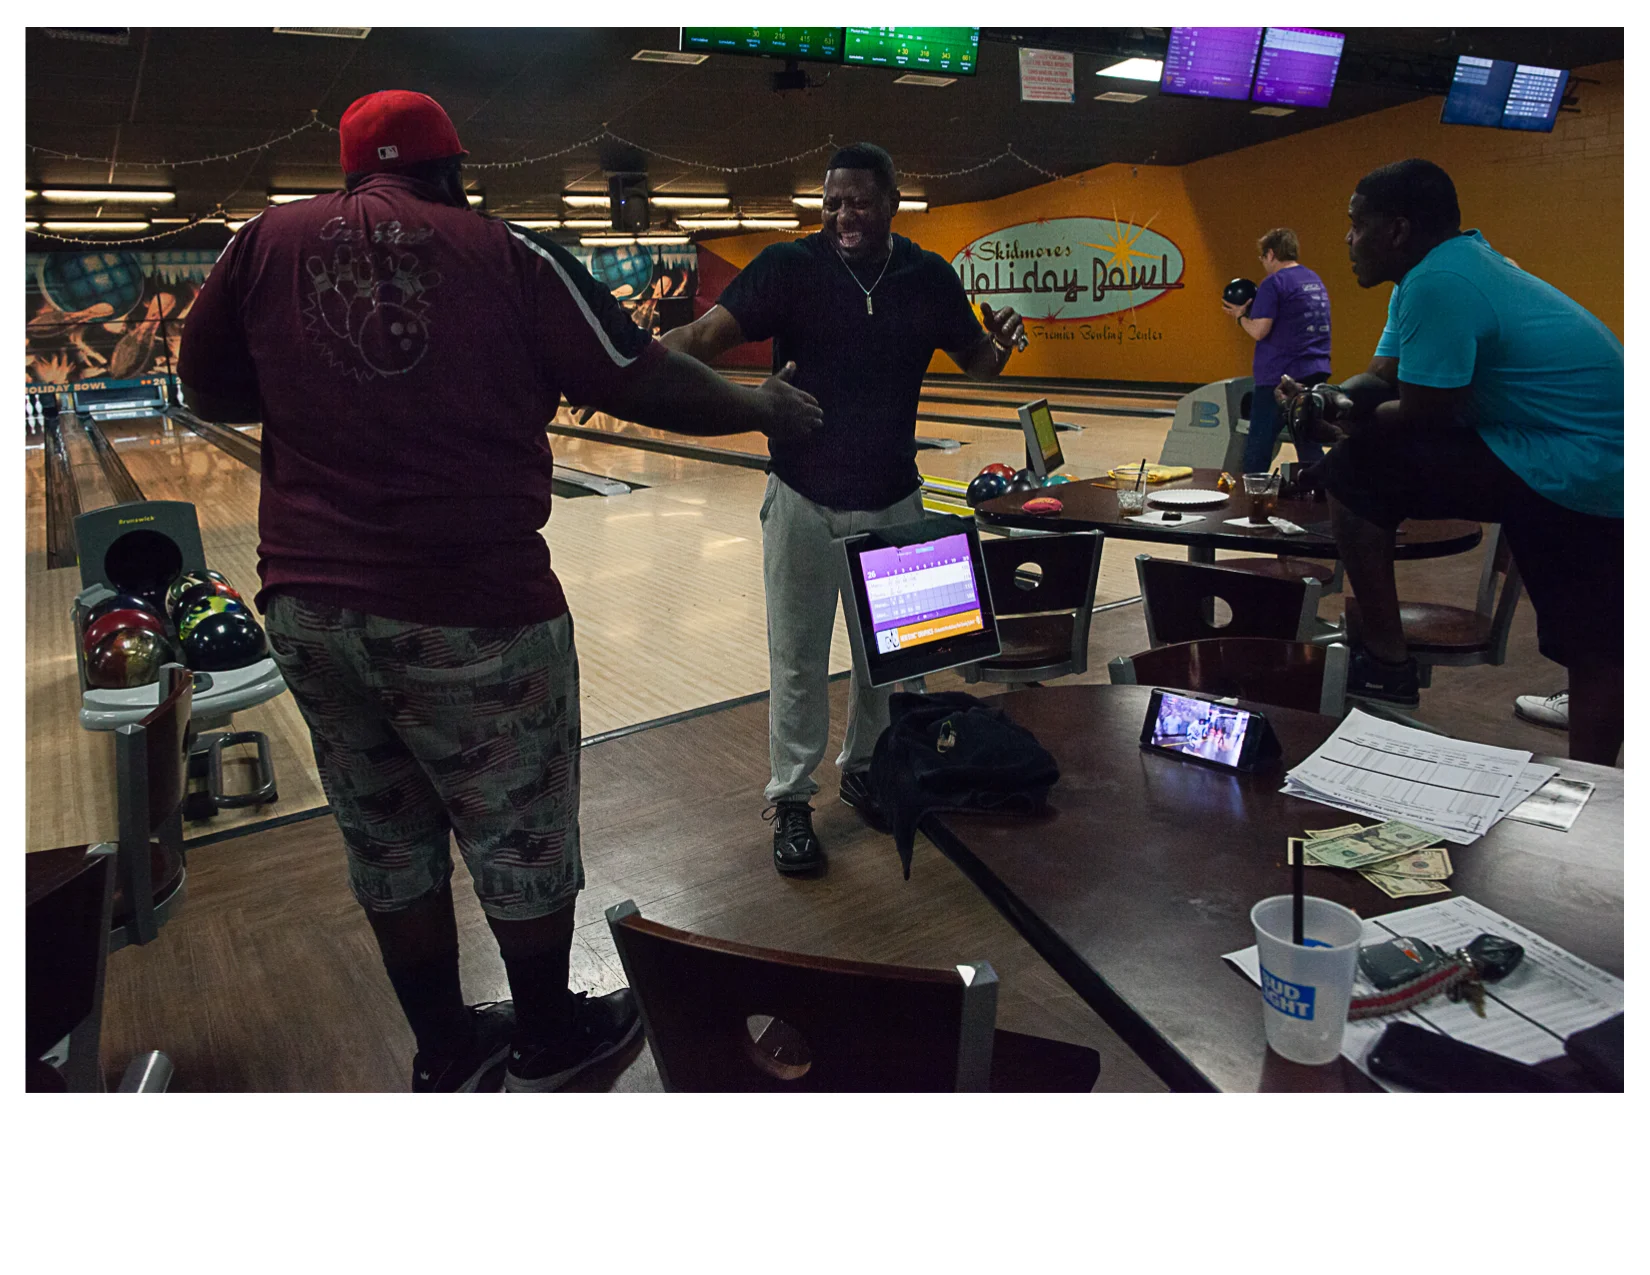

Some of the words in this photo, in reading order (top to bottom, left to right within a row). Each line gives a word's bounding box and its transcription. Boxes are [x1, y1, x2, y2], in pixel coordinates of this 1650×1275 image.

[960, 261, 1088, 305] Holiday
[1092, 254, 1184, 302] Bowl
[1079, 325, 1123, 344] Bowling
[1127, 325, 1163, 341] Center
[74, 382, 107, 392] BOWL
[118, 515, 155, 525] Brunswick
[867, 570, 876, 579] 26
